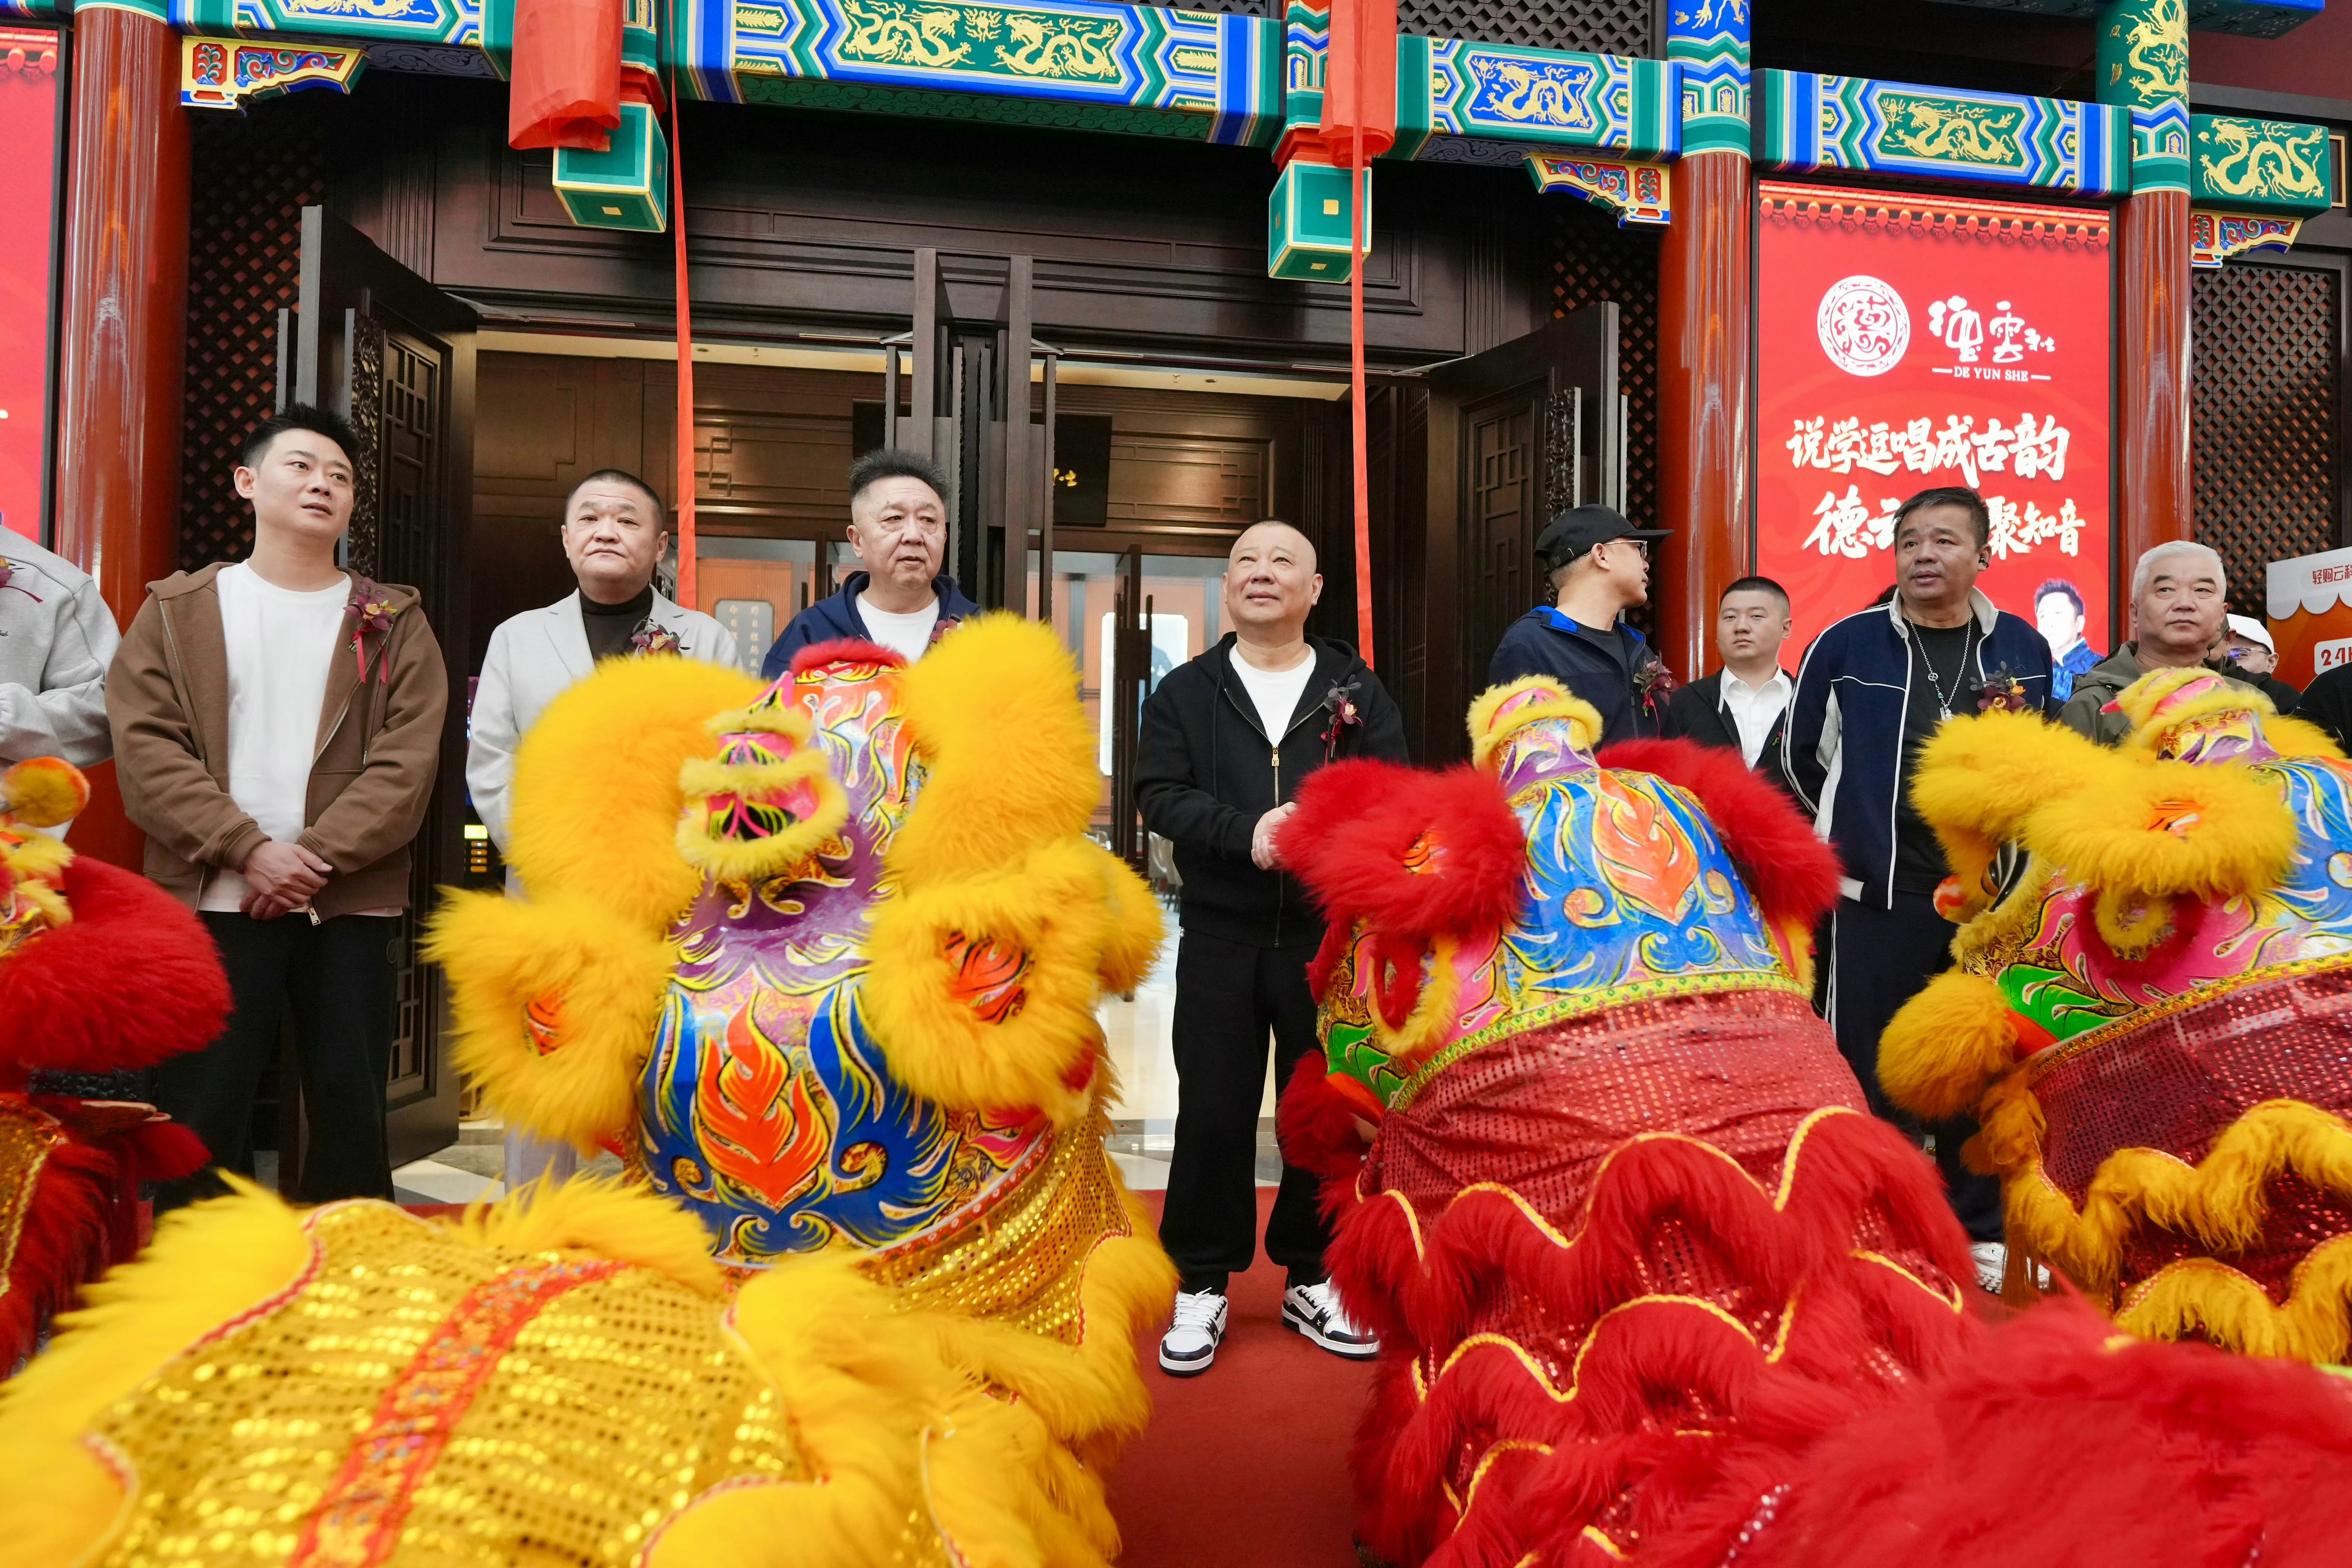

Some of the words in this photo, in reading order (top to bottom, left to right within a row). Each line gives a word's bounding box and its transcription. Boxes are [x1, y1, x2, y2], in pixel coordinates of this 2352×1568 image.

[1954, 366, 1970, 378] DE
[1974, 367, 2000, 380] YUN
[2004, 369, 2028, 381] SHE
[1786, 413, 2070, 489] 说学逗唱成古韵
[1801, 484, 2086, 560] 德云聚知音
[2312, 564, 2352, 585] 轻购云科
